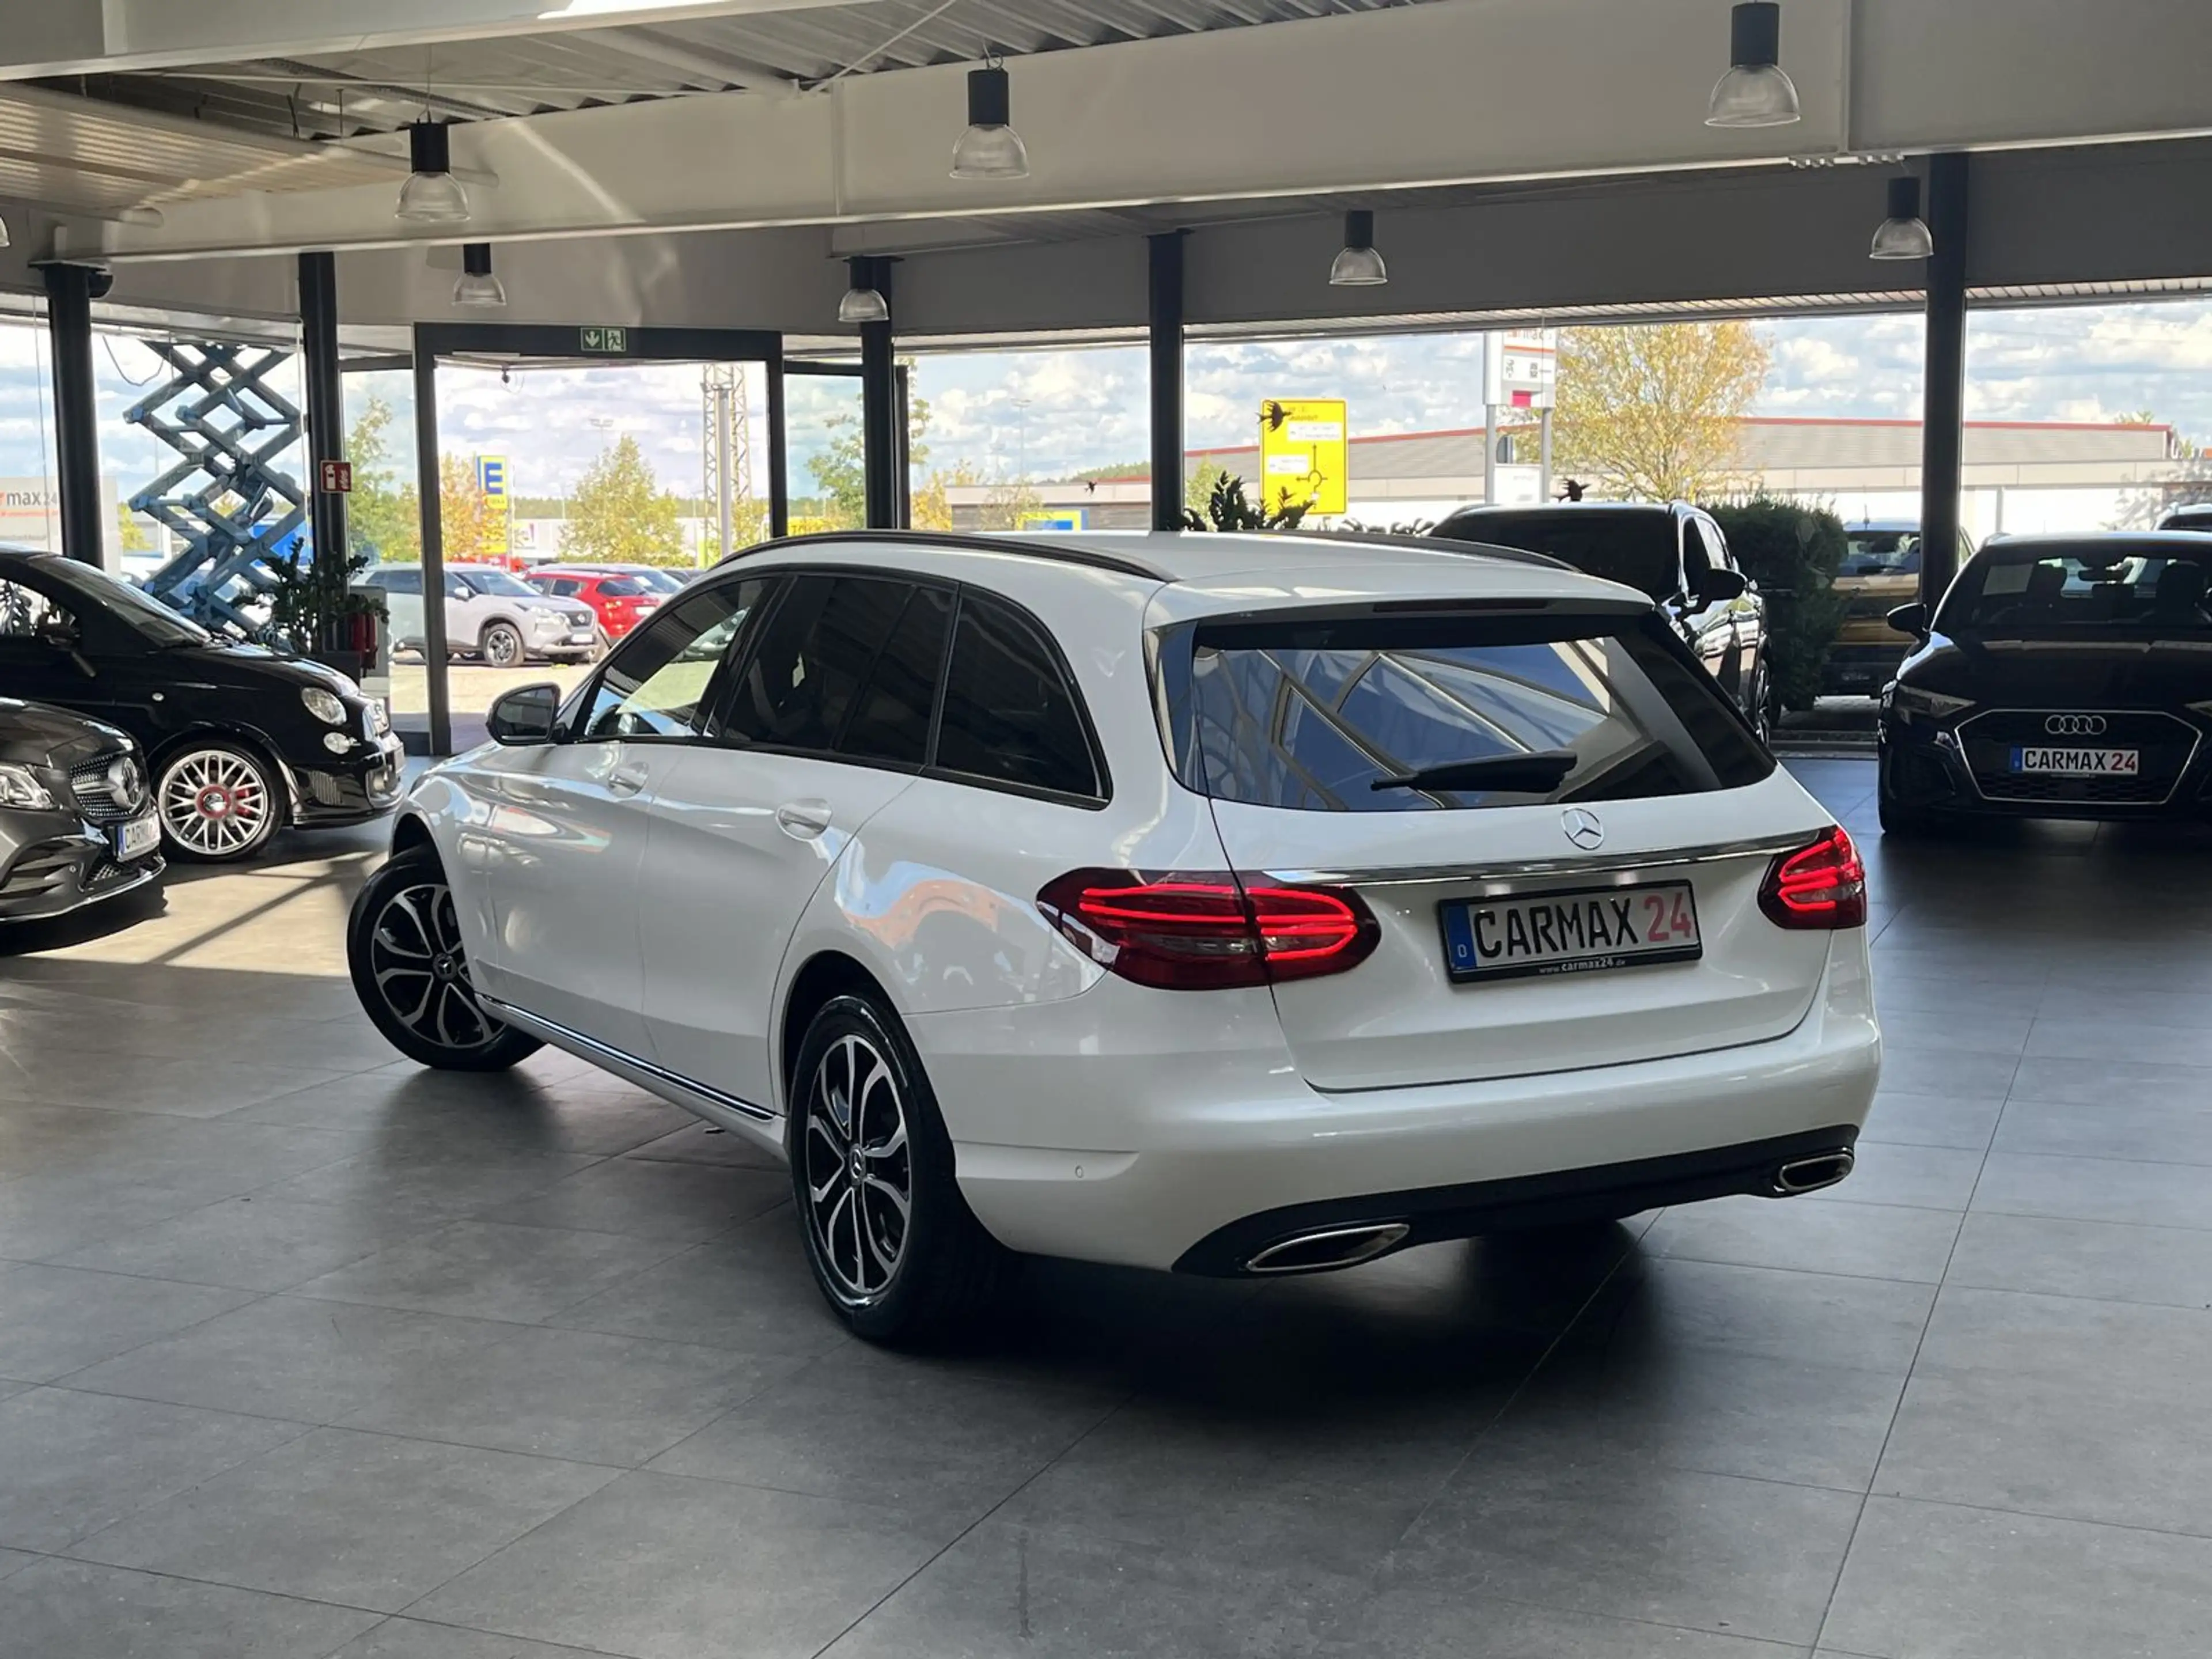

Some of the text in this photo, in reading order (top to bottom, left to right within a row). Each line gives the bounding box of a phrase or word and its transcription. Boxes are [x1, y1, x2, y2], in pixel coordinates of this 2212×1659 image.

[2025, 750, 2136, 771] CARMAX 24
[1473, 892, 1692, 958] CARMAX 24
